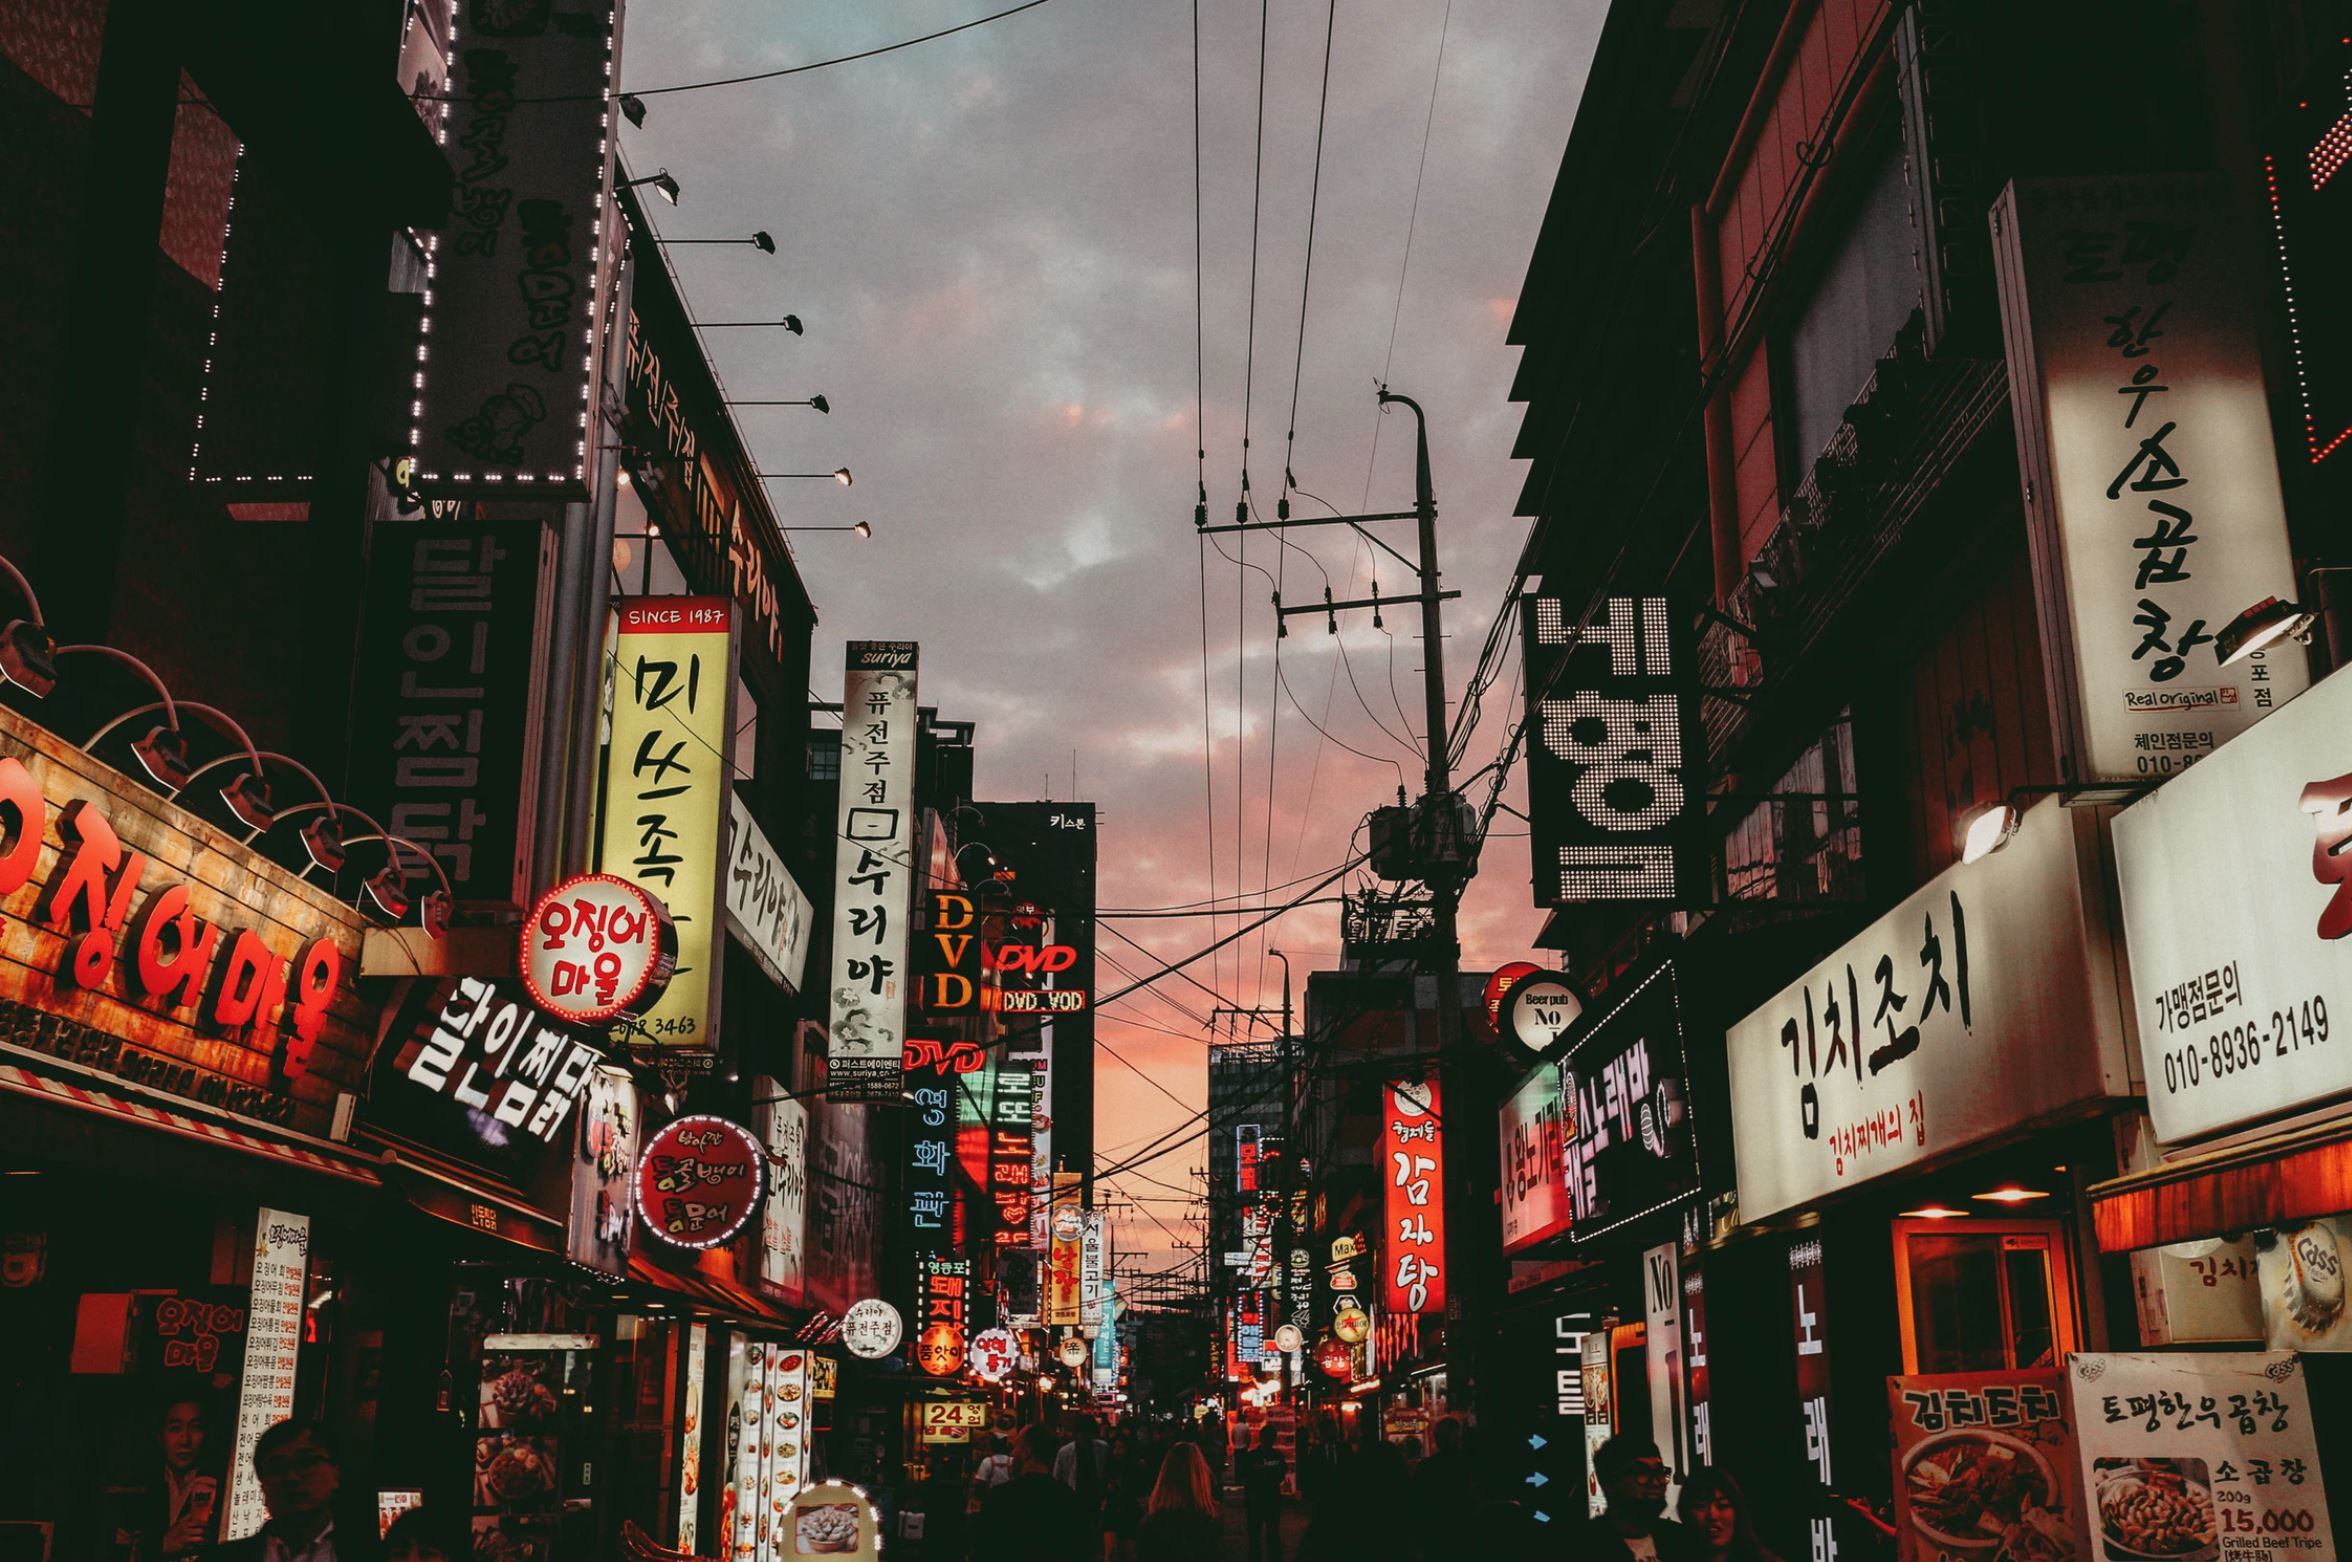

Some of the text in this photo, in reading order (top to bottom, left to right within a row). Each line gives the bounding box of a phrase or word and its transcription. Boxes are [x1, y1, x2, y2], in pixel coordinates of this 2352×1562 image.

[628, 609, 726, 628] SINCE 1987
[861, 651, 911, 668] suriya
[2125, 691, 2156, 706] Real
[863, 691, 892, 804] 퓨전주점
[2133, 731, 2214, 751] 체인점문의
[539, 896, 647, 956] 오징어
[848, 850, 894, 995] 수리야
[934, 895, 975, 1007] DVD
[996, 945, 1077, 972] DVD
[550, 954, 622, 1006] 마을
[1526, 994, 1547, 1006] Beer
[2156, 960, 2244, 1034] 가맹점문의
[655, 1017, 696, 1035] 3463
[1782, 890, 1972, 1138] 김치조치
[2164, 994, 2330, 1094] 010-8936-2149
[903, 1040, 985, 1076] DVD
[1908, 1089, 1925, 1147] 집
[1392, 1121, 1434, 1143] 형제들
[1392, 1152, 1439, 1312] 감자탕
[928, 1262, 966, 1275] 영등포
[1086, 1222, 1102, 1298] 서울불고기
[2297, 1237, 2339, 1277] Cass
[847, 1320, 892, 1338] 퓨전주점
[921, 1344, 963, 1364] 품앗이
[930, 1405, 963, 1424] 24
[2216, 1490, 2251, 1504] 200g
[2221, 1508, 2313, 1533] 15,000
[2223, 1536, 2322, 1551] Grilled Beef Tripe
